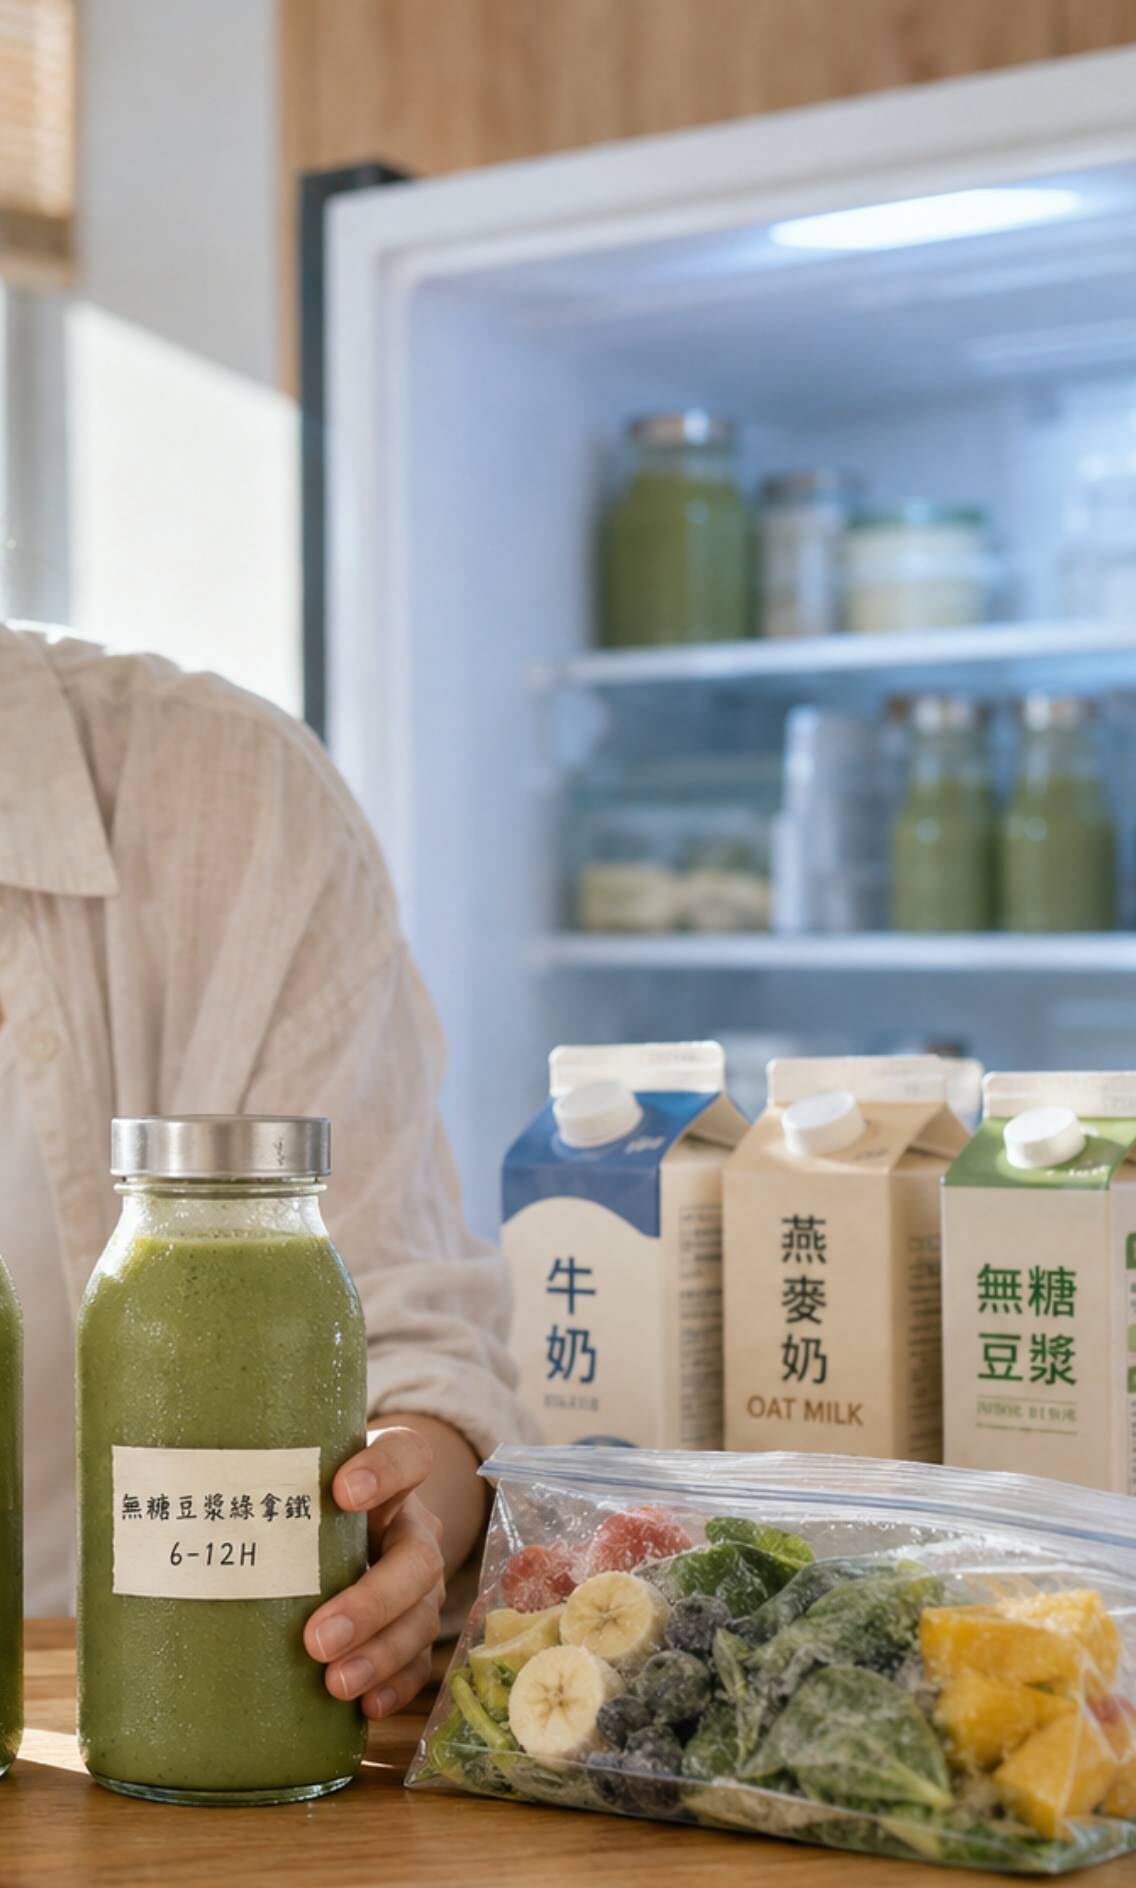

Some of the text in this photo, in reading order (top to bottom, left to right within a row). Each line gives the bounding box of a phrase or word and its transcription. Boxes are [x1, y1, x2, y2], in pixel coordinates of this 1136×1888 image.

[780, 1213, 828, 1384] 燕麥奶
[976, 1263, 1078, 1318] 無糖
[546, 1256, 597, 1384] 牛奶
[976, 1332, 1078, 1386] 豆漿
[747, 1396, 864, 1427] OAT MILK
[121, 1492, 312, 1522] 無糖豆漿綠拿鐵
[169, 1541, 257, 1567] 6-12H
